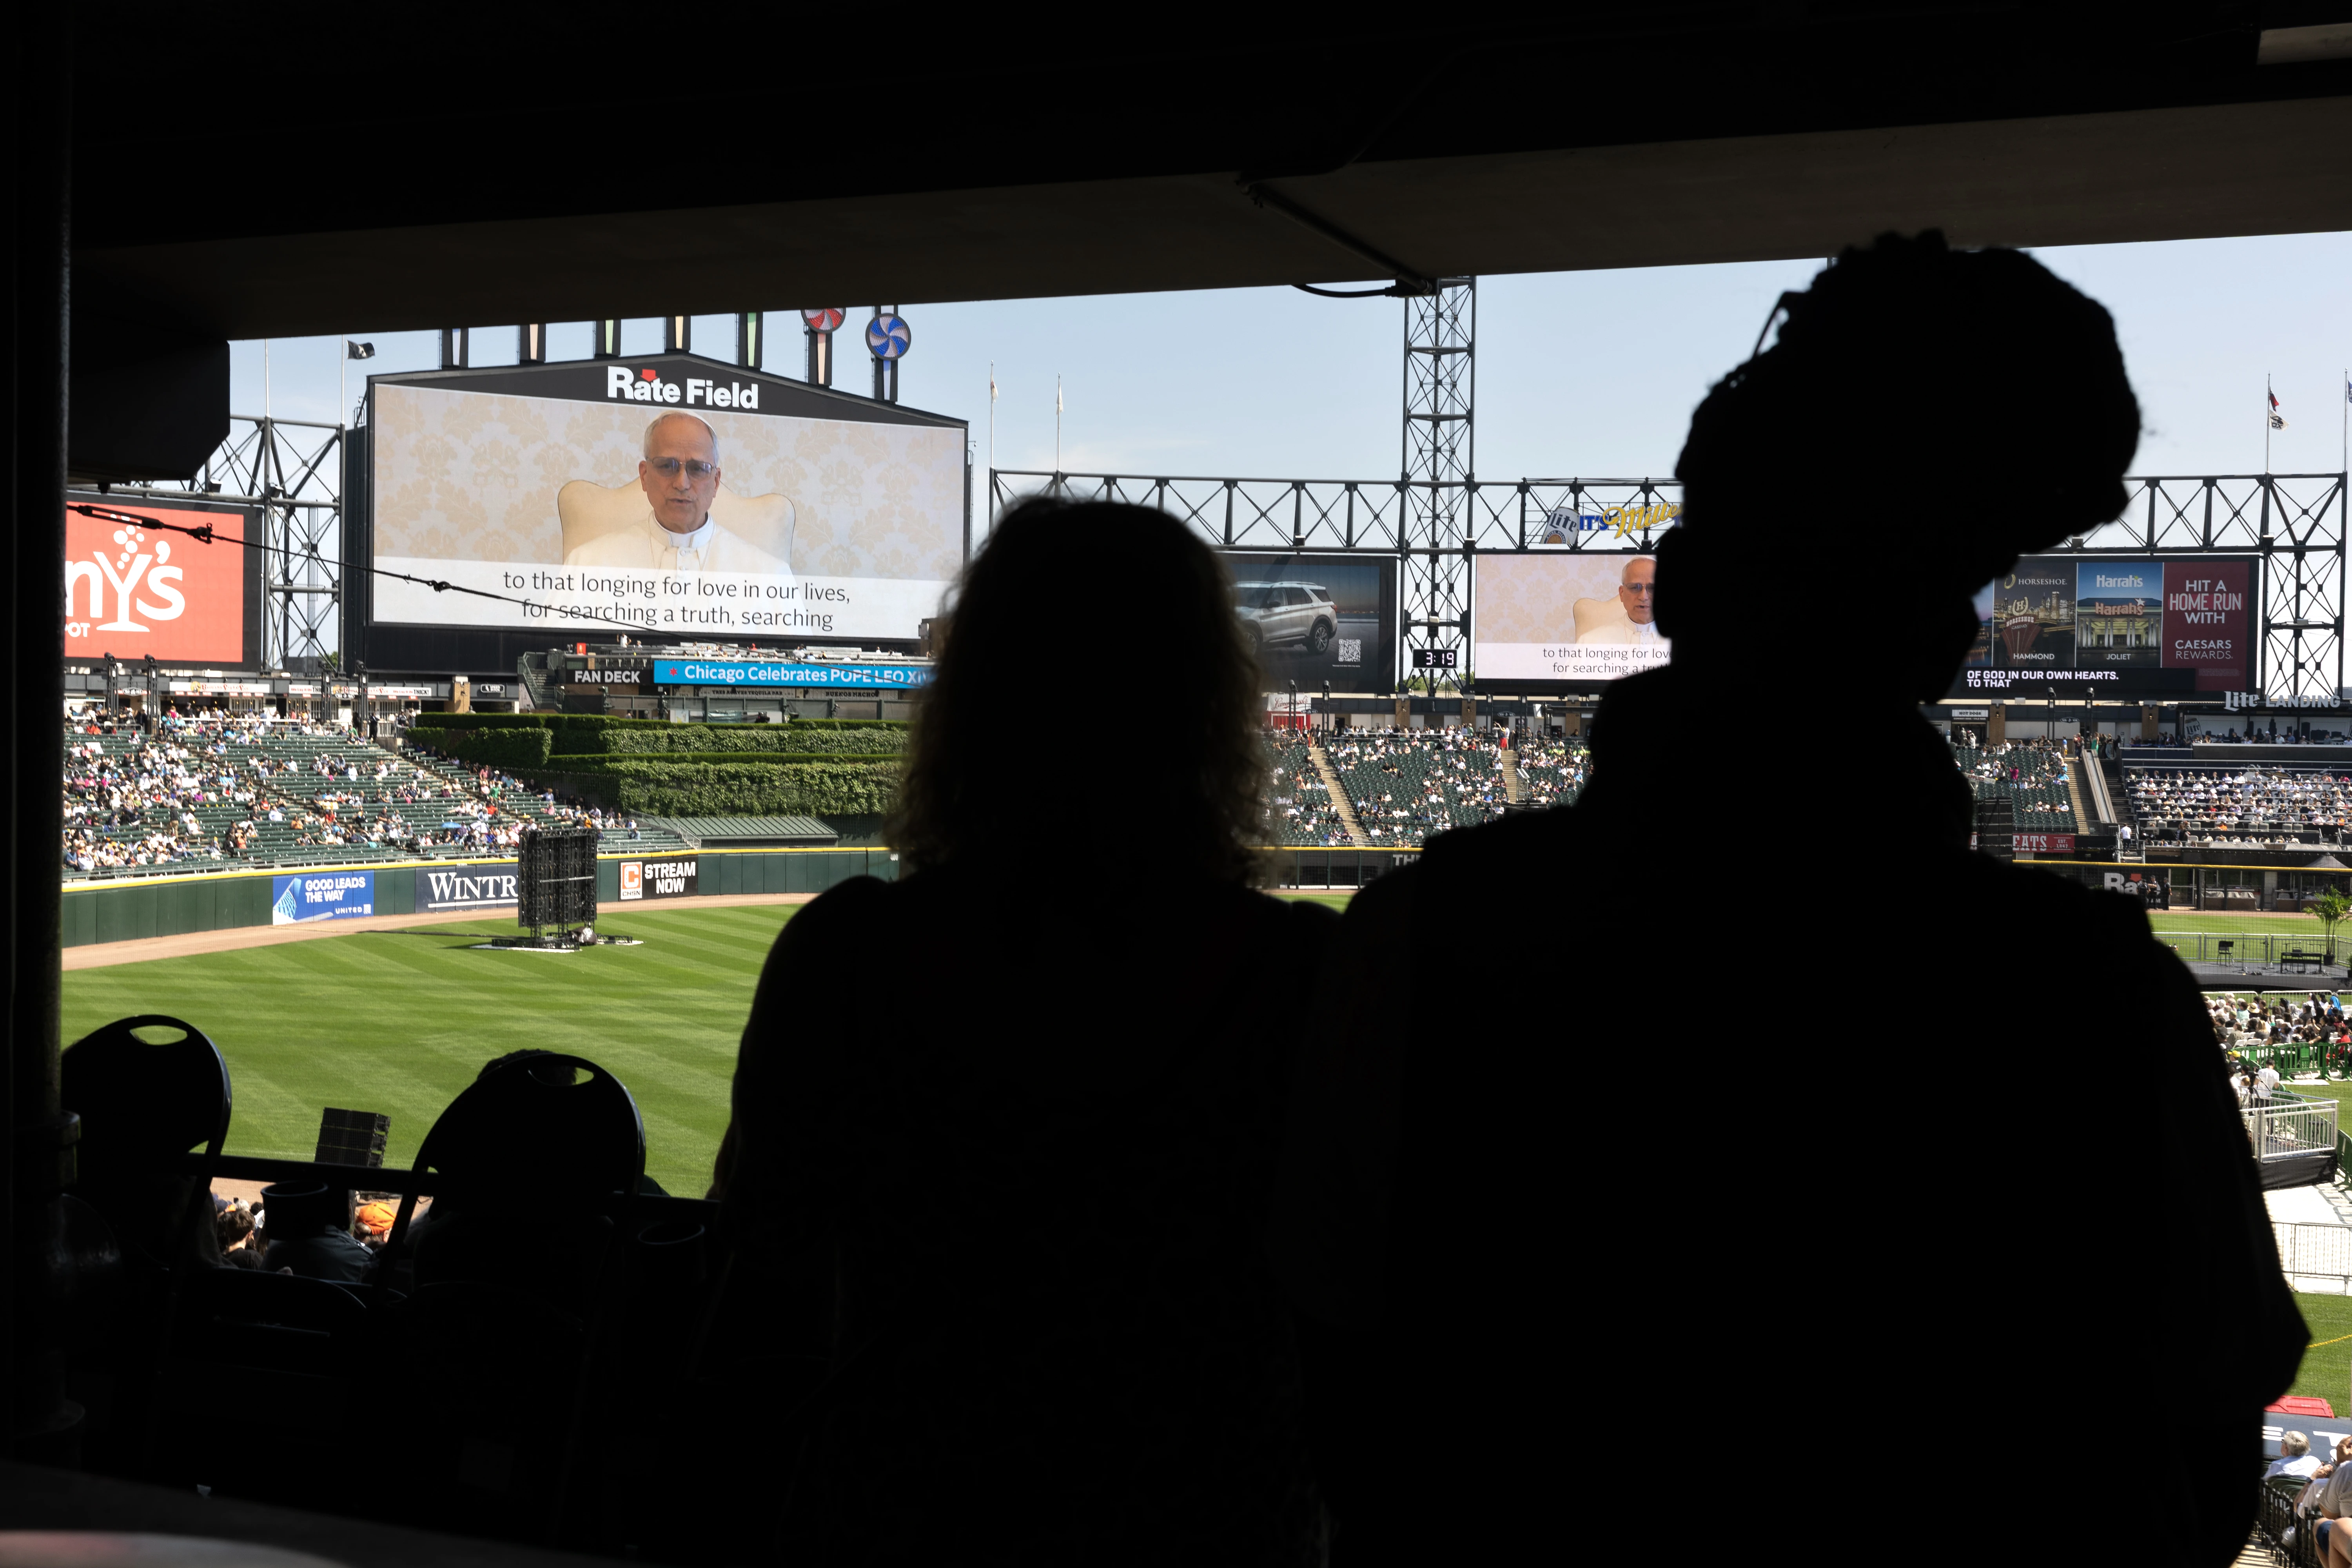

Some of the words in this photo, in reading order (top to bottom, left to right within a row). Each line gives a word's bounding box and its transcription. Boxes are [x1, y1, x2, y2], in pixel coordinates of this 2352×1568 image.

[608, 366, 681, 403] Rate
[687, 378, 758, 409] Field
[1549, 513, 1577, 532] Lite
[504, 572, 524, 588] to
[532, 571, 574, 590] that
[583, 573, 656, 598] longing
[662, 576, 691, 595] for
[698, 578, 737, 597] love
[744, 580, 759, 598] in
[766, 585, 798, 599] our
[805, 583, 849, 604] lives,
[2186, 580, 2211, 592] HIT
[2215, 580, 2227, 592] A
[2170, 593, 2209, 610] HOME
[2214, 593, 2241, 610] RUN
[522, 599, 552, 618] for
[559, 602, 657, 626] searching
[664, 609, 674, 622] a
[681, 606, 734, 626] truth,
[742, 609, 833, 632] searching
[2006, 616, 2034, 627] HORSESHOE
[2185, 612, 2225, 624] WITH
[65, 622, 91, 637] OT
[2175, 640, 2231, 649] CAESARS
[1426, 652, 1454, 665] 3:19
[1543, 648, 1555, 658] to
[1558, 648, 1582, 658] that
[1586, 648, 1628, 661] longing
[1632, 648, 1648, 658] for
[2176, 651, 2231, 659] REWARDS
[685, 665, 744, 683] Chicago
[748, 667, 828, 682] Celebrates
[831, 669, 871, 682] POPE
[875, 670, 904, 683] LEO
[1553, 662, 1569, 673] for
[1573, 663, 1628, 676] searching
[1967, 671, 1981, 679] OF
[1983, 671, 2005, 679] GOD
[2008, 671, 2019, 679] IN
[2022, 671, 2044, 679] OUR
[2047, 671, 2072, 679] OWN
[2075, 671, 2119, 680] HEARTS.
[575, 670, 601, 683] FAN
[605, 671, 640, 684] DECK
[1967, 679, 1981, 687] TO
[1983, 679, 2011, 688] THAT
[2224, 691, 2259, 711] Lite
[2266, 695, 2340, 708] LANDING
[644, 862, 696, 879] STREAM
[305, 878, 334, 891] GOOD
[335, 877, 365, 889] LEADS
[428, 872, 518, 901] WINTR
[656, 878, 685, 894] NOW
[305, 891, 322, 903] THE
[324, 890, 345, 902] WAY
[335, 906, 362, 914] UNITED
